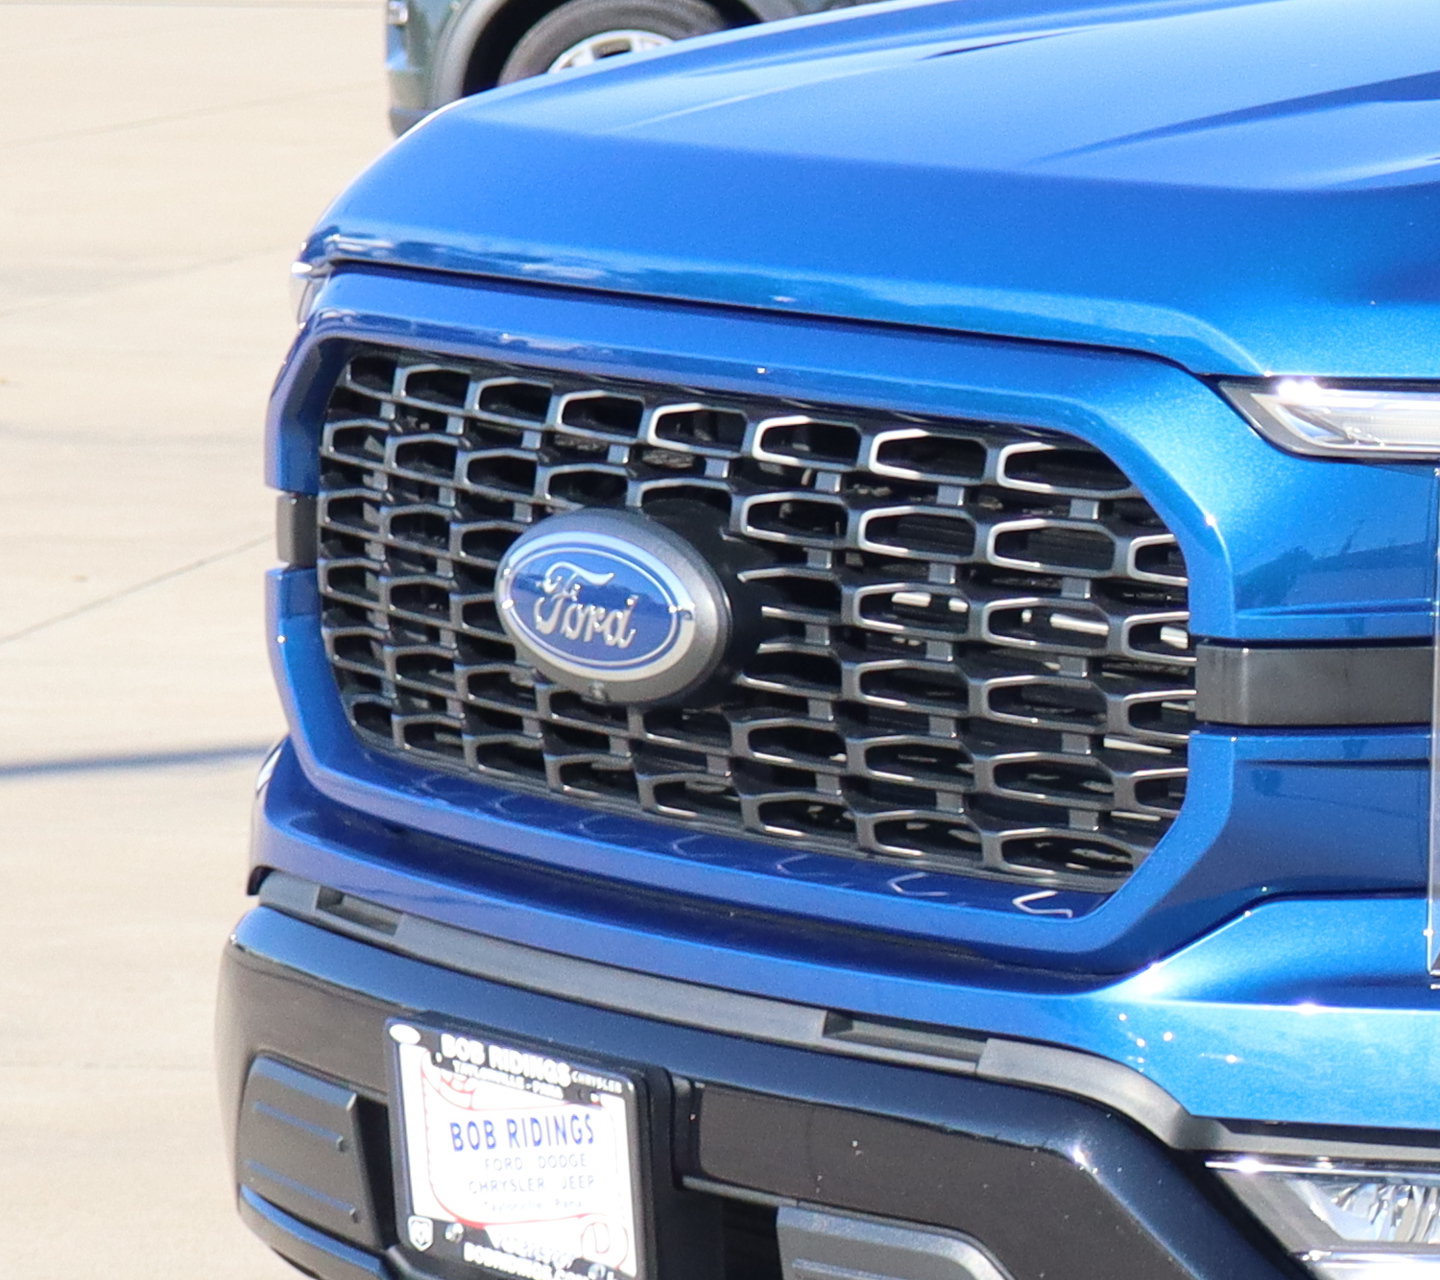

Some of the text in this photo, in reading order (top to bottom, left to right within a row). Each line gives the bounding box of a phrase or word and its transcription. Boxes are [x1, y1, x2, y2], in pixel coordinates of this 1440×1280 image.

[533, 561, 639, 649] Ford
[440, 1033, 485, 1066] BOB
[450, 1114, 594, 1152] BOB RIDINGS
[484, 1153, 586, 1171] FORD DODGE
[468, 1174, 595, 1194] CHRYSLER JEEP
